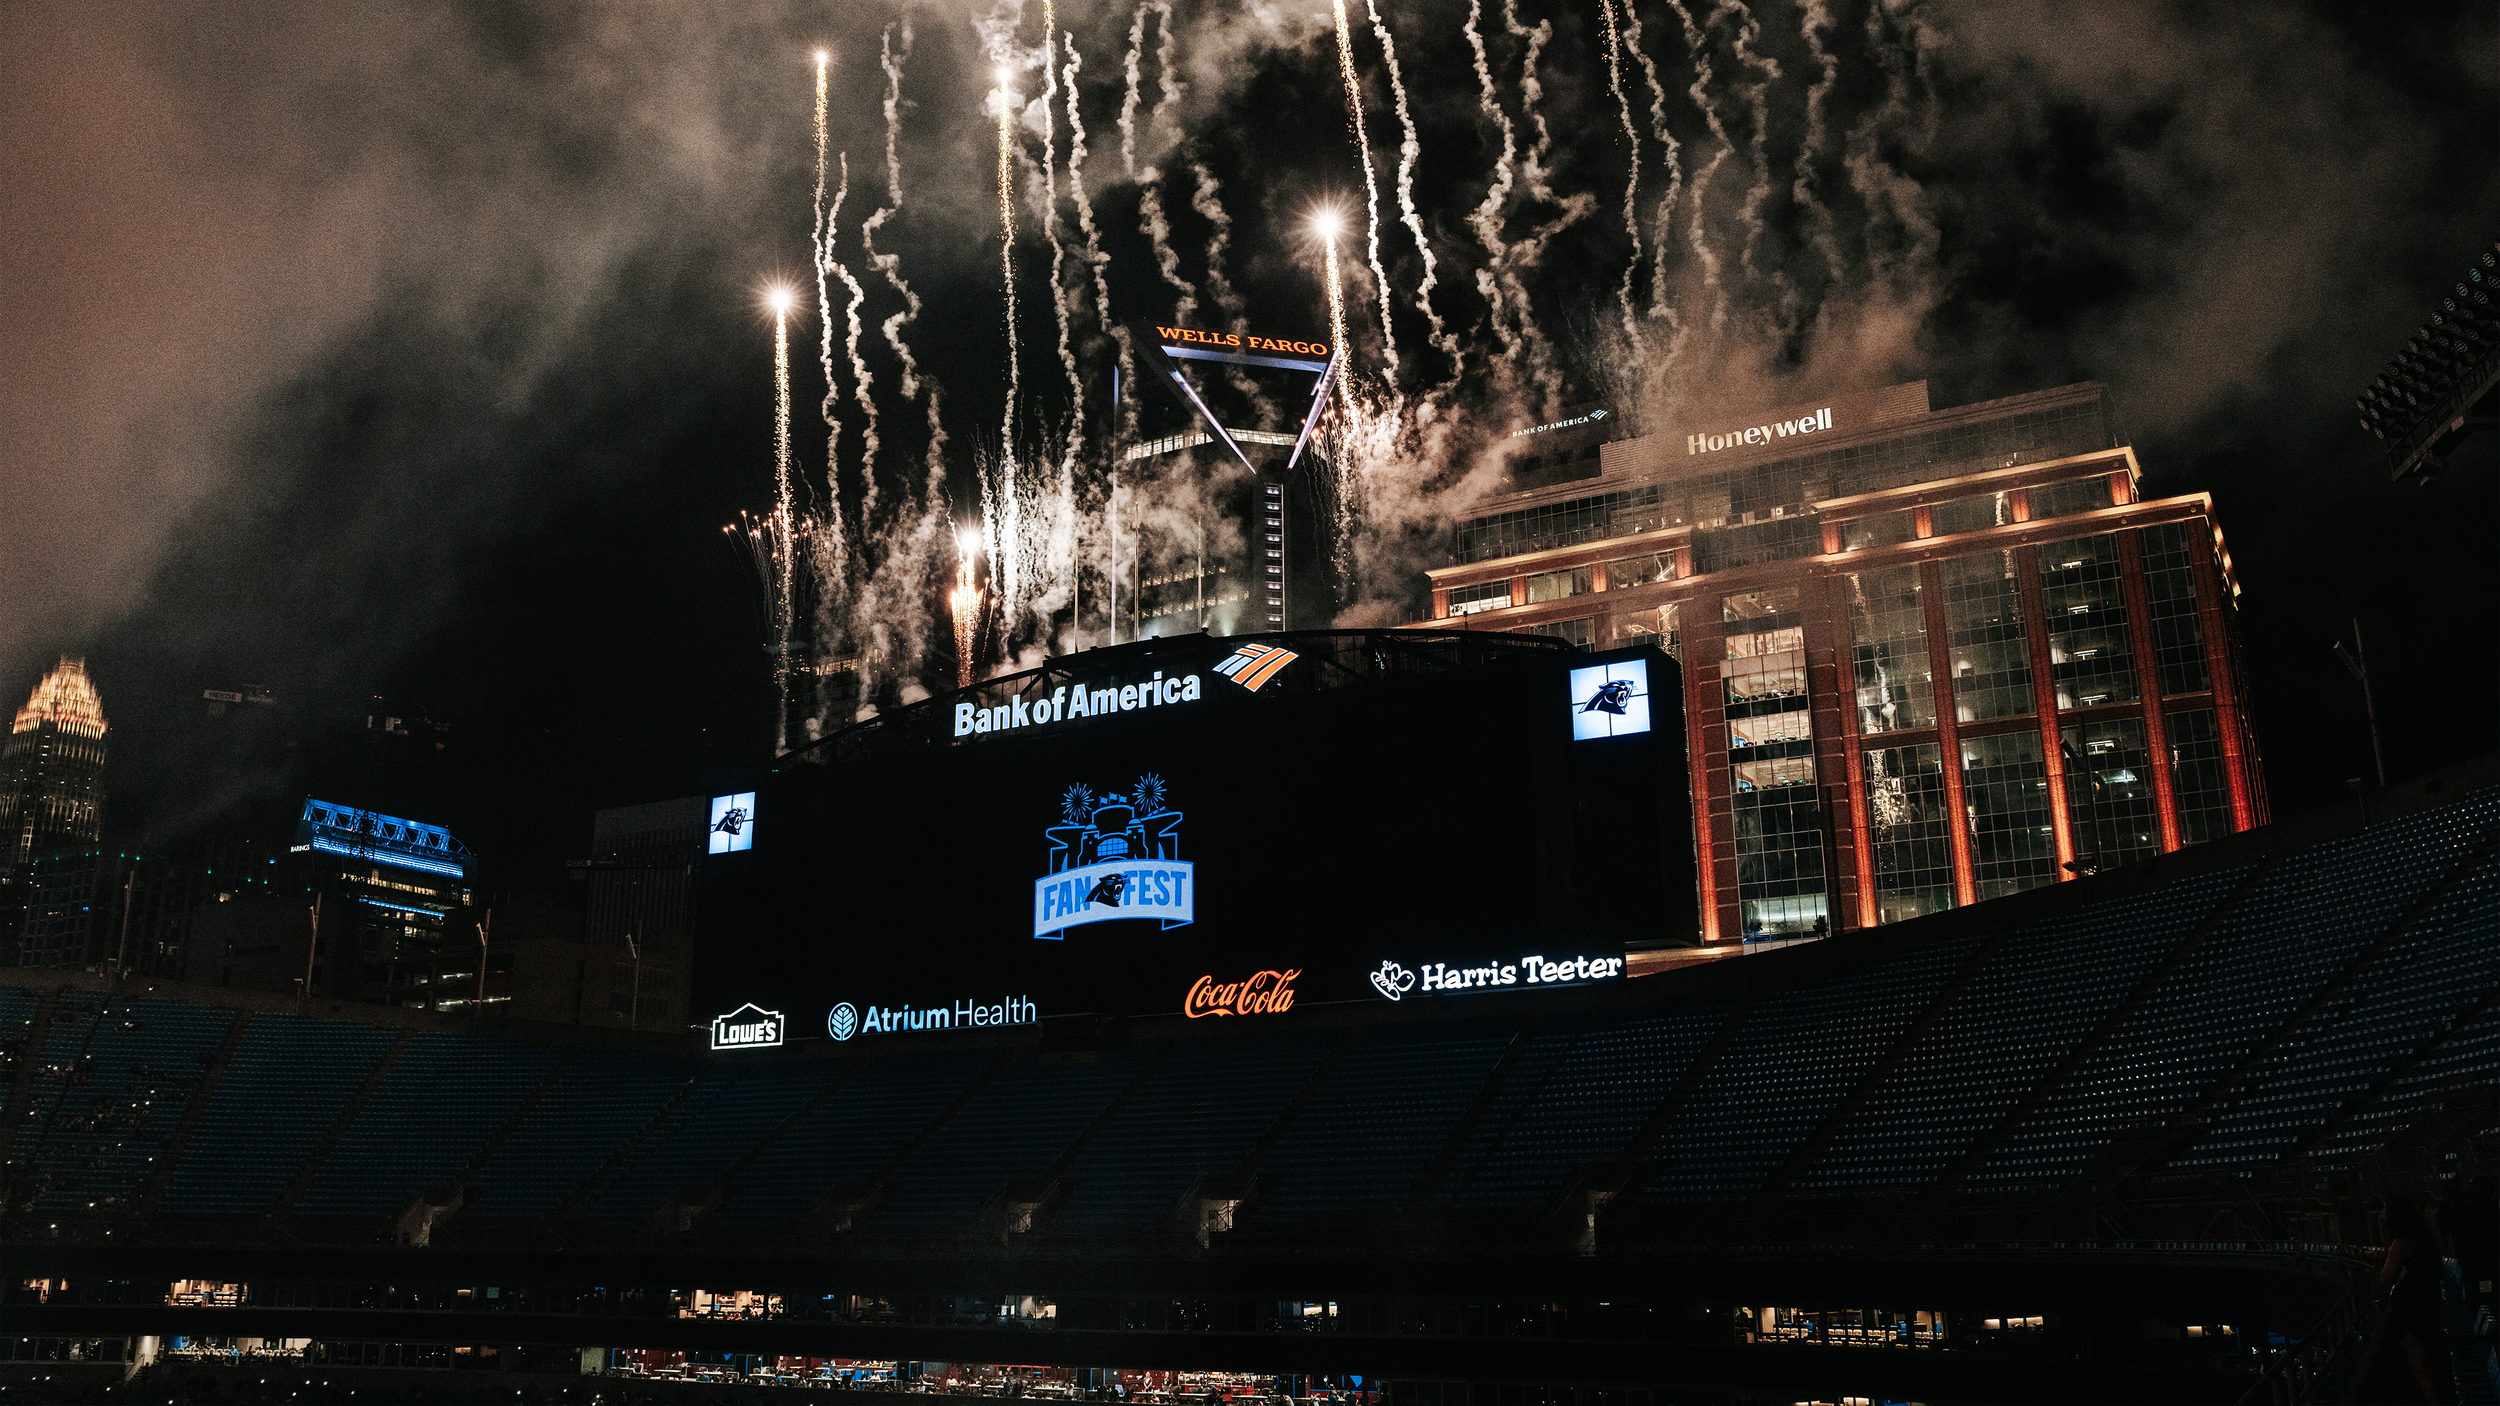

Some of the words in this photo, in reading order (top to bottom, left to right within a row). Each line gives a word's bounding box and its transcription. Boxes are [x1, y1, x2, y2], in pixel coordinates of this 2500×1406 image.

[1156, 326, 1241, 346] WELLS
[1247, 336, 1328, 355] FARGO
[1512, 427, 1536, 437] BANK
[1537, 424, 1548, 432] OF
[1549, 416, 1589, 430] AMERICA
[1687, 407, 1832, 455] Honeywell
[208, 691, 238, 700] HEEDE
[954, 694, 1031, 737] Bank
[1033, 686, 1066, 722] of
[1068, 671, 1201, 719] America
[1043, 875, 1092, 922] FAN
[1123, 869, 1187, 907] FEST
[1421, 961, 1517, 991] Harris
[1521, 955, 1623, 984] Teeter
[1184, 968, 1302, 1018] Coca-Cola
[719, 1019, 777, 1044] LOWE'S
[861, 1004, 950, 1034] Atrium
[955, 995, 1037, 1027] Health
